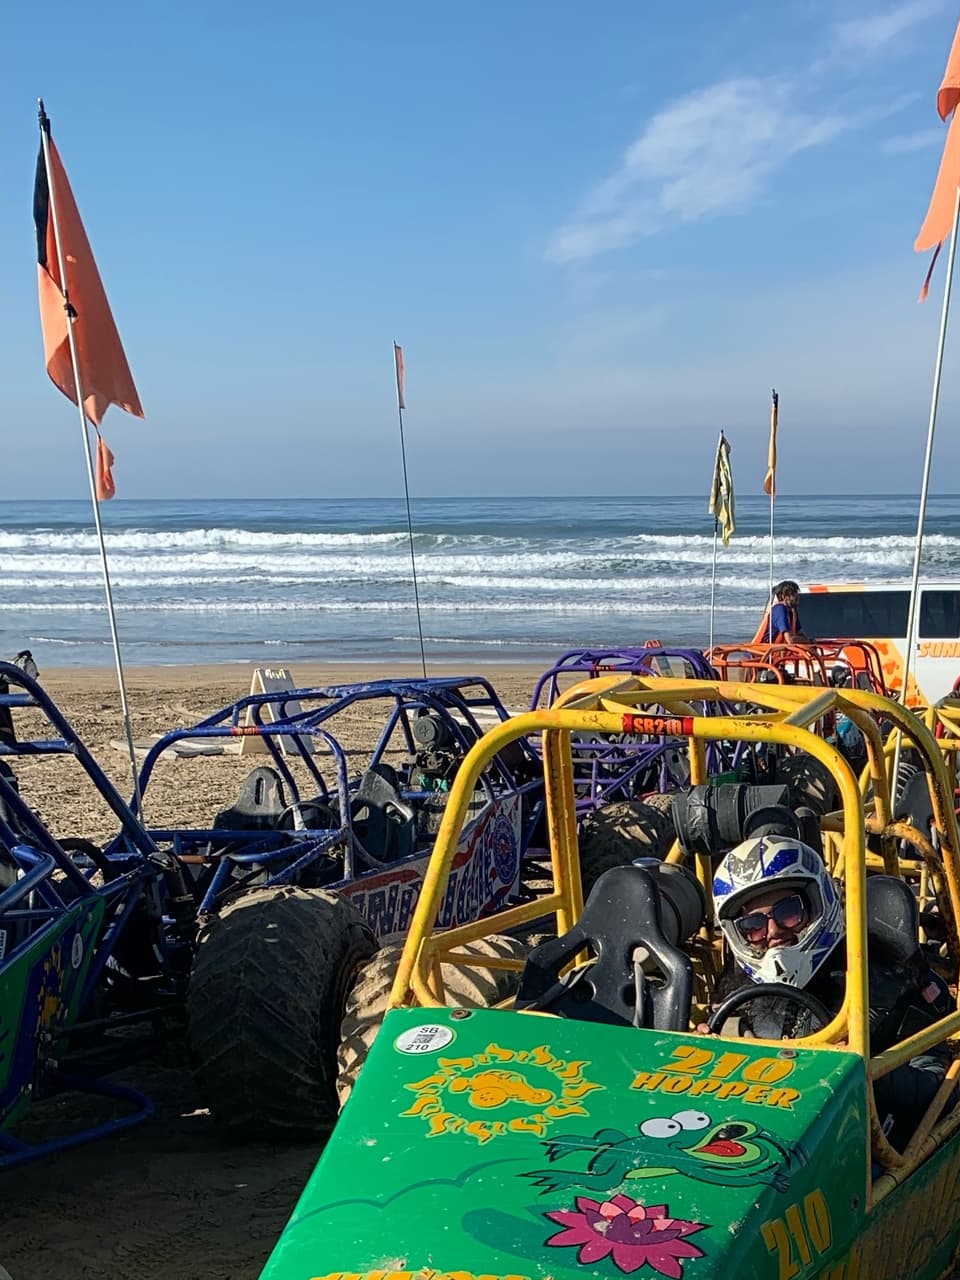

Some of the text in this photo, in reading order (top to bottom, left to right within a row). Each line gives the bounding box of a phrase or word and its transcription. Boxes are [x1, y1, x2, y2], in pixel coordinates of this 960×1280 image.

[633, 716, 682, 736] SB210
[656, 1045, 796, 1084] 210
[631, 1071, 801, 1109] HOPPER
